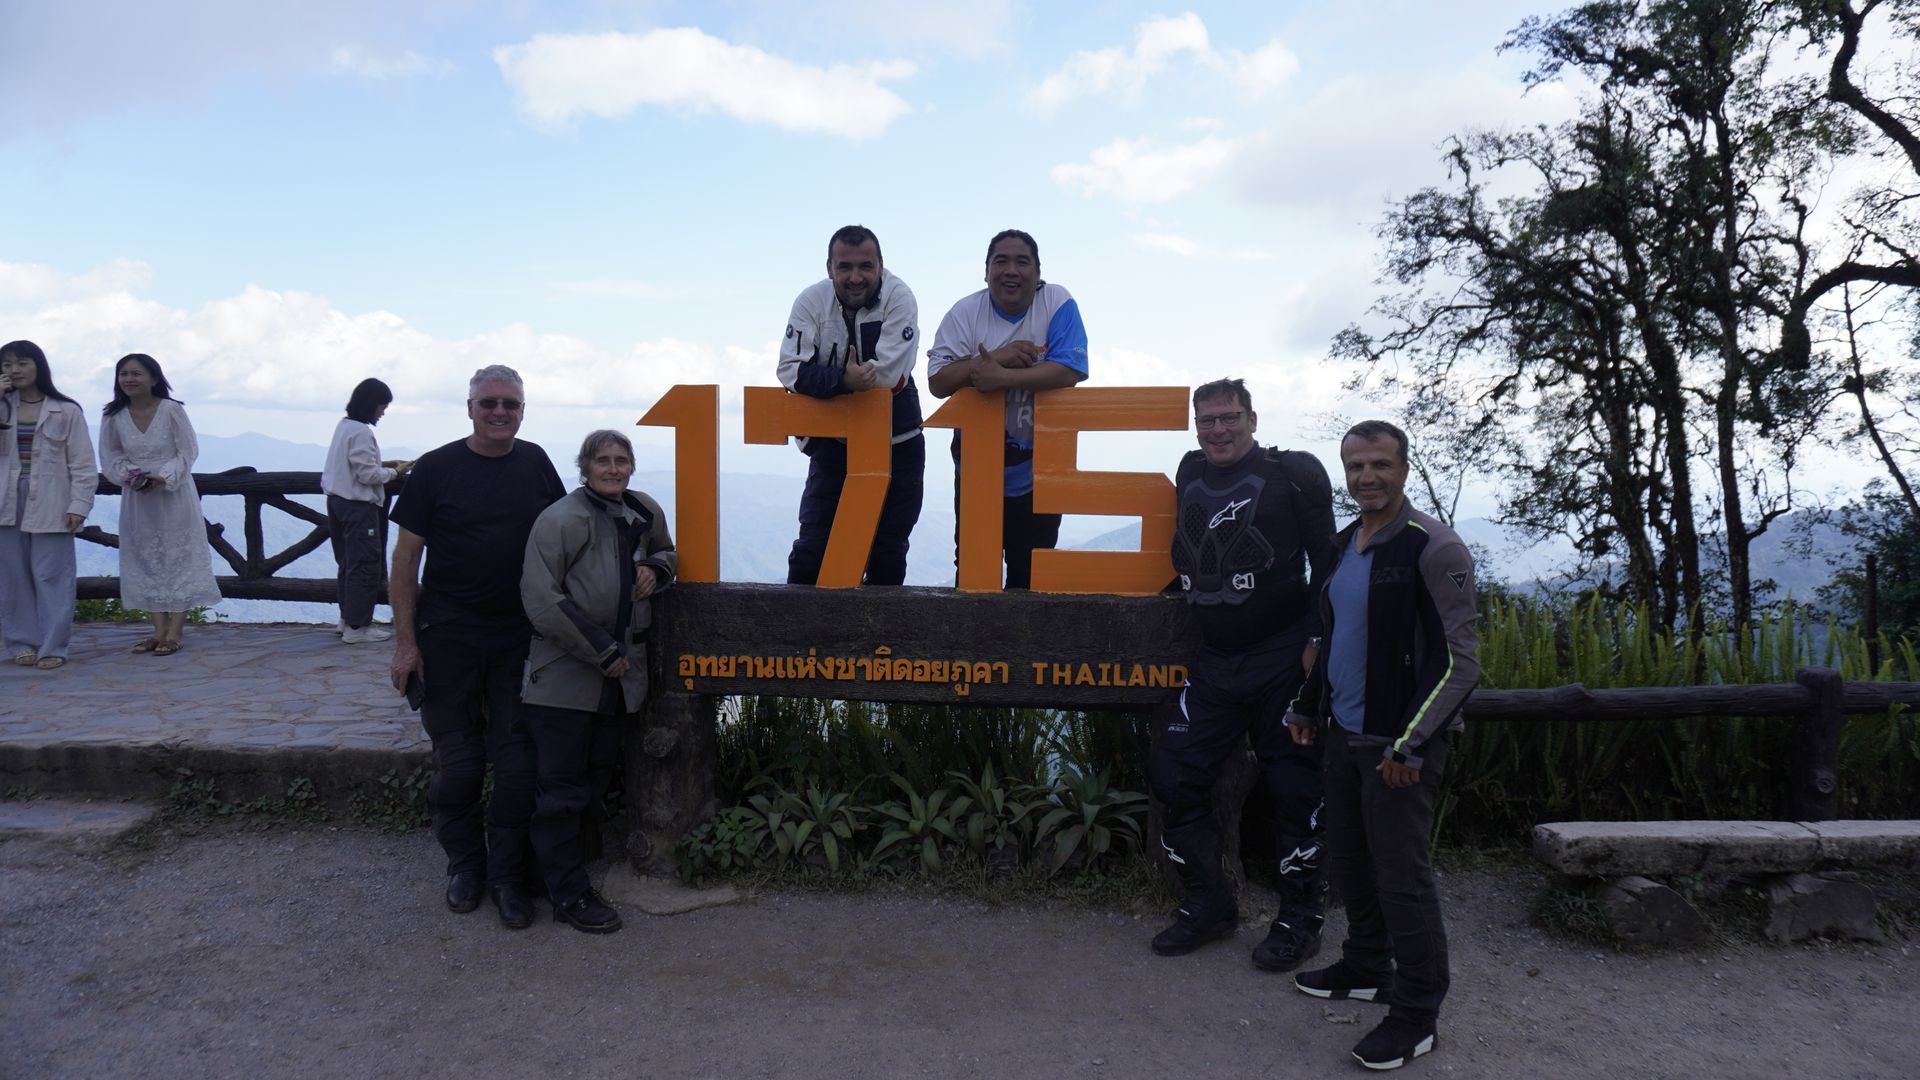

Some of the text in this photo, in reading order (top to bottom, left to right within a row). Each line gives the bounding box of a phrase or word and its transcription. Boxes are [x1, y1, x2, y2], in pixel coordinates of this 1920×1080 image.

[636, 384, 1190, 594] 1715
[679, 648, 1009, 696] อุทยานแห่งชาติดอยภูคา
[1032, 662, 1189, 688] THAILAND
